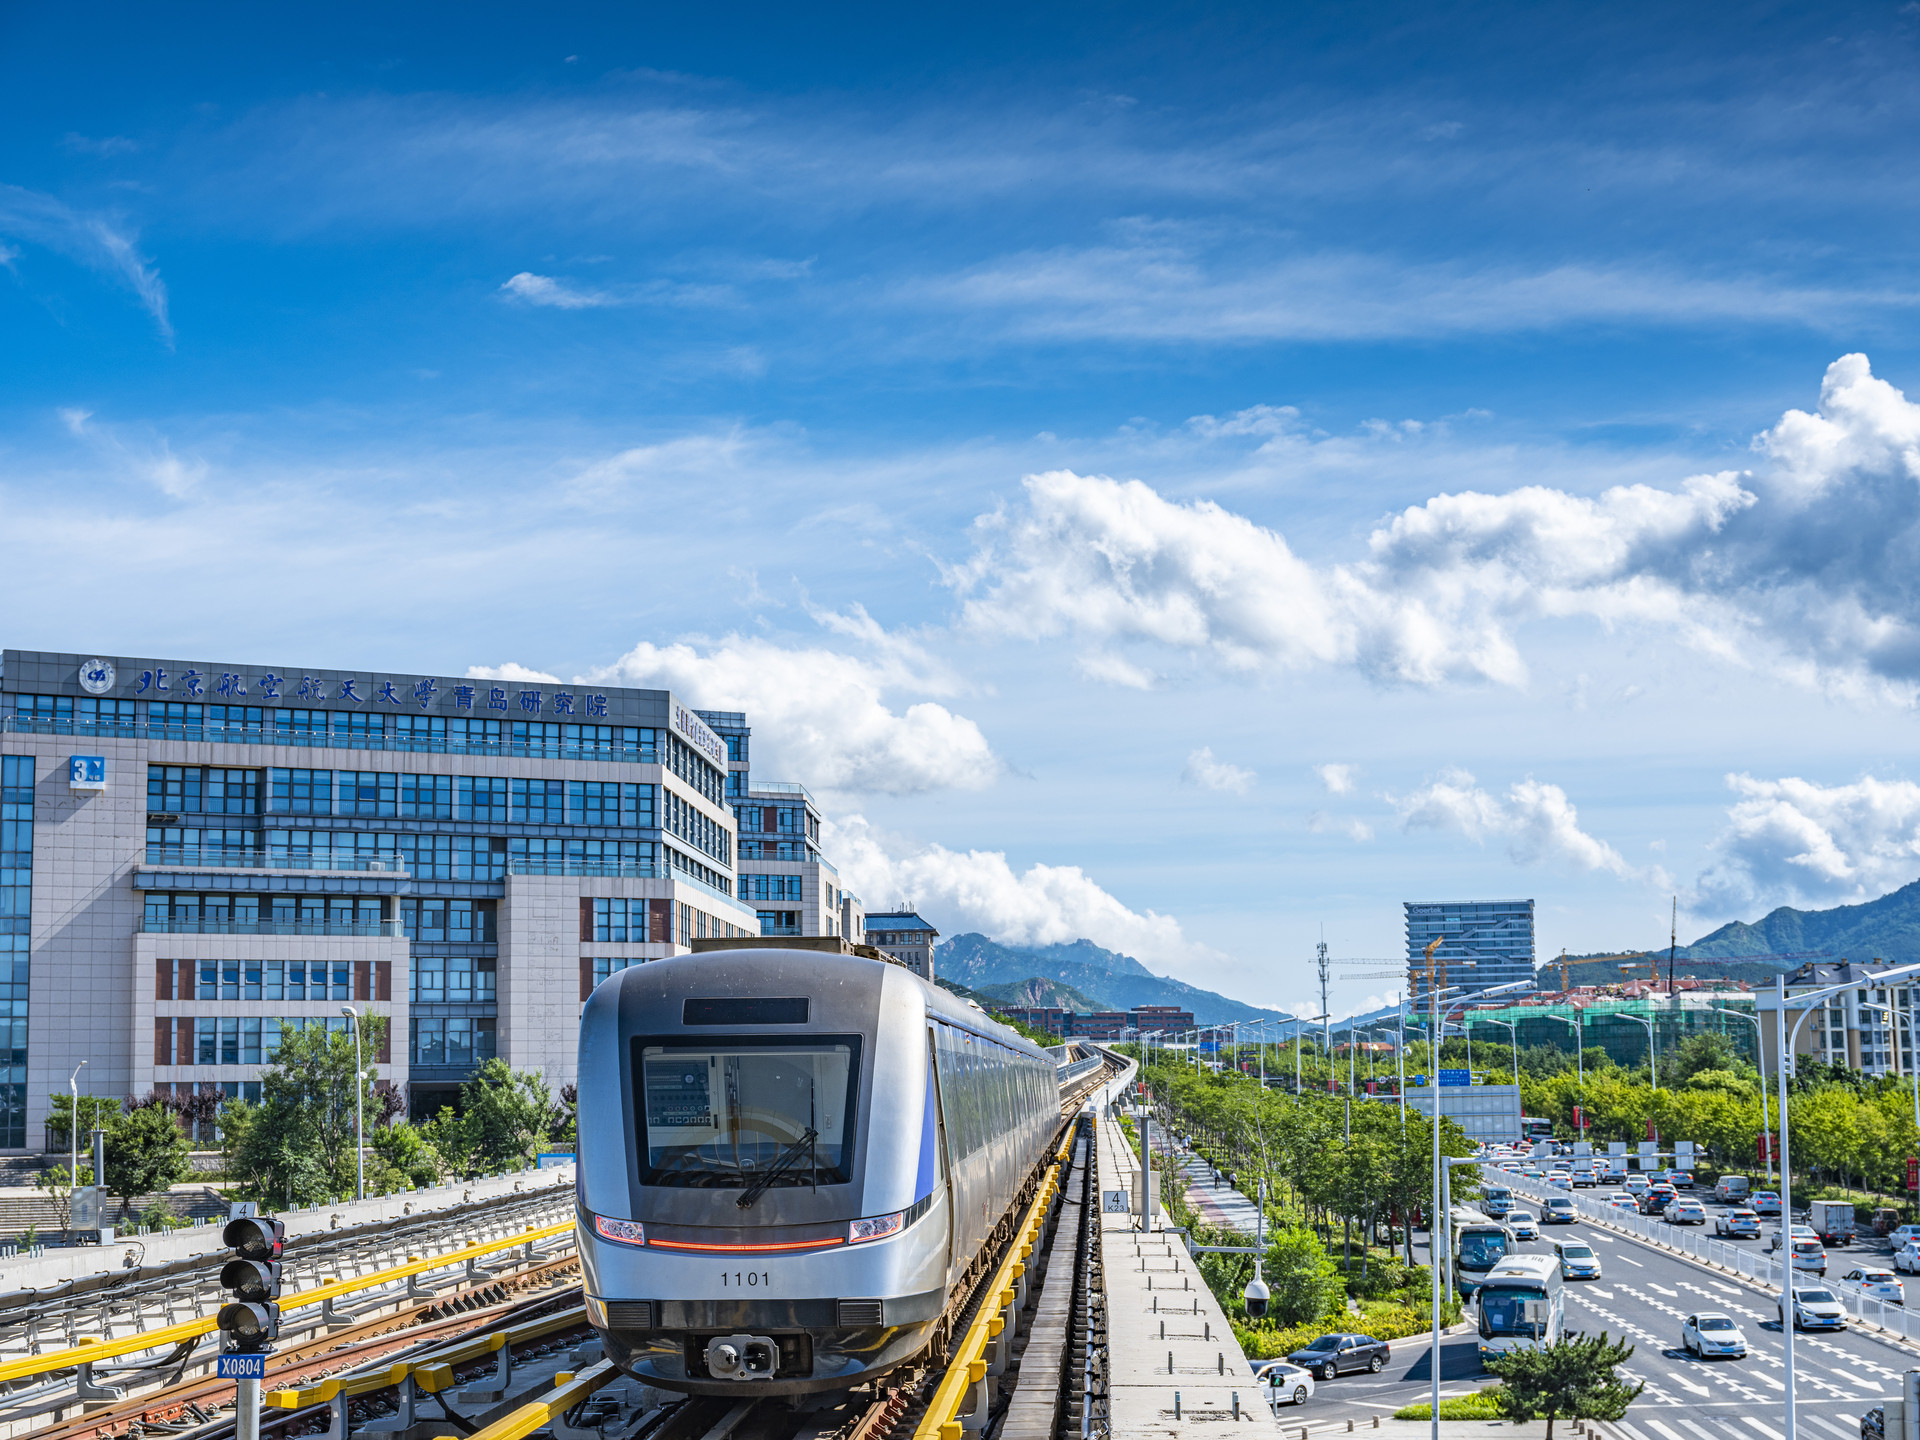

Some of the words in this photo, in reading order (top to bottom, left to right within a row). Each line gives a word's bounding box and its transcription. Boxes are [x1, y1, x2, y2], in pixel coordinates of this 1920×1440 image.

[74, 760, 87, 782] 3
[1112, 1193, 1120, 1205] 4
[239, 1204, 247, 1217] 4
[721, 1271, 769, 1287] 1101
[221, 1358, 261, 1376] X0804
